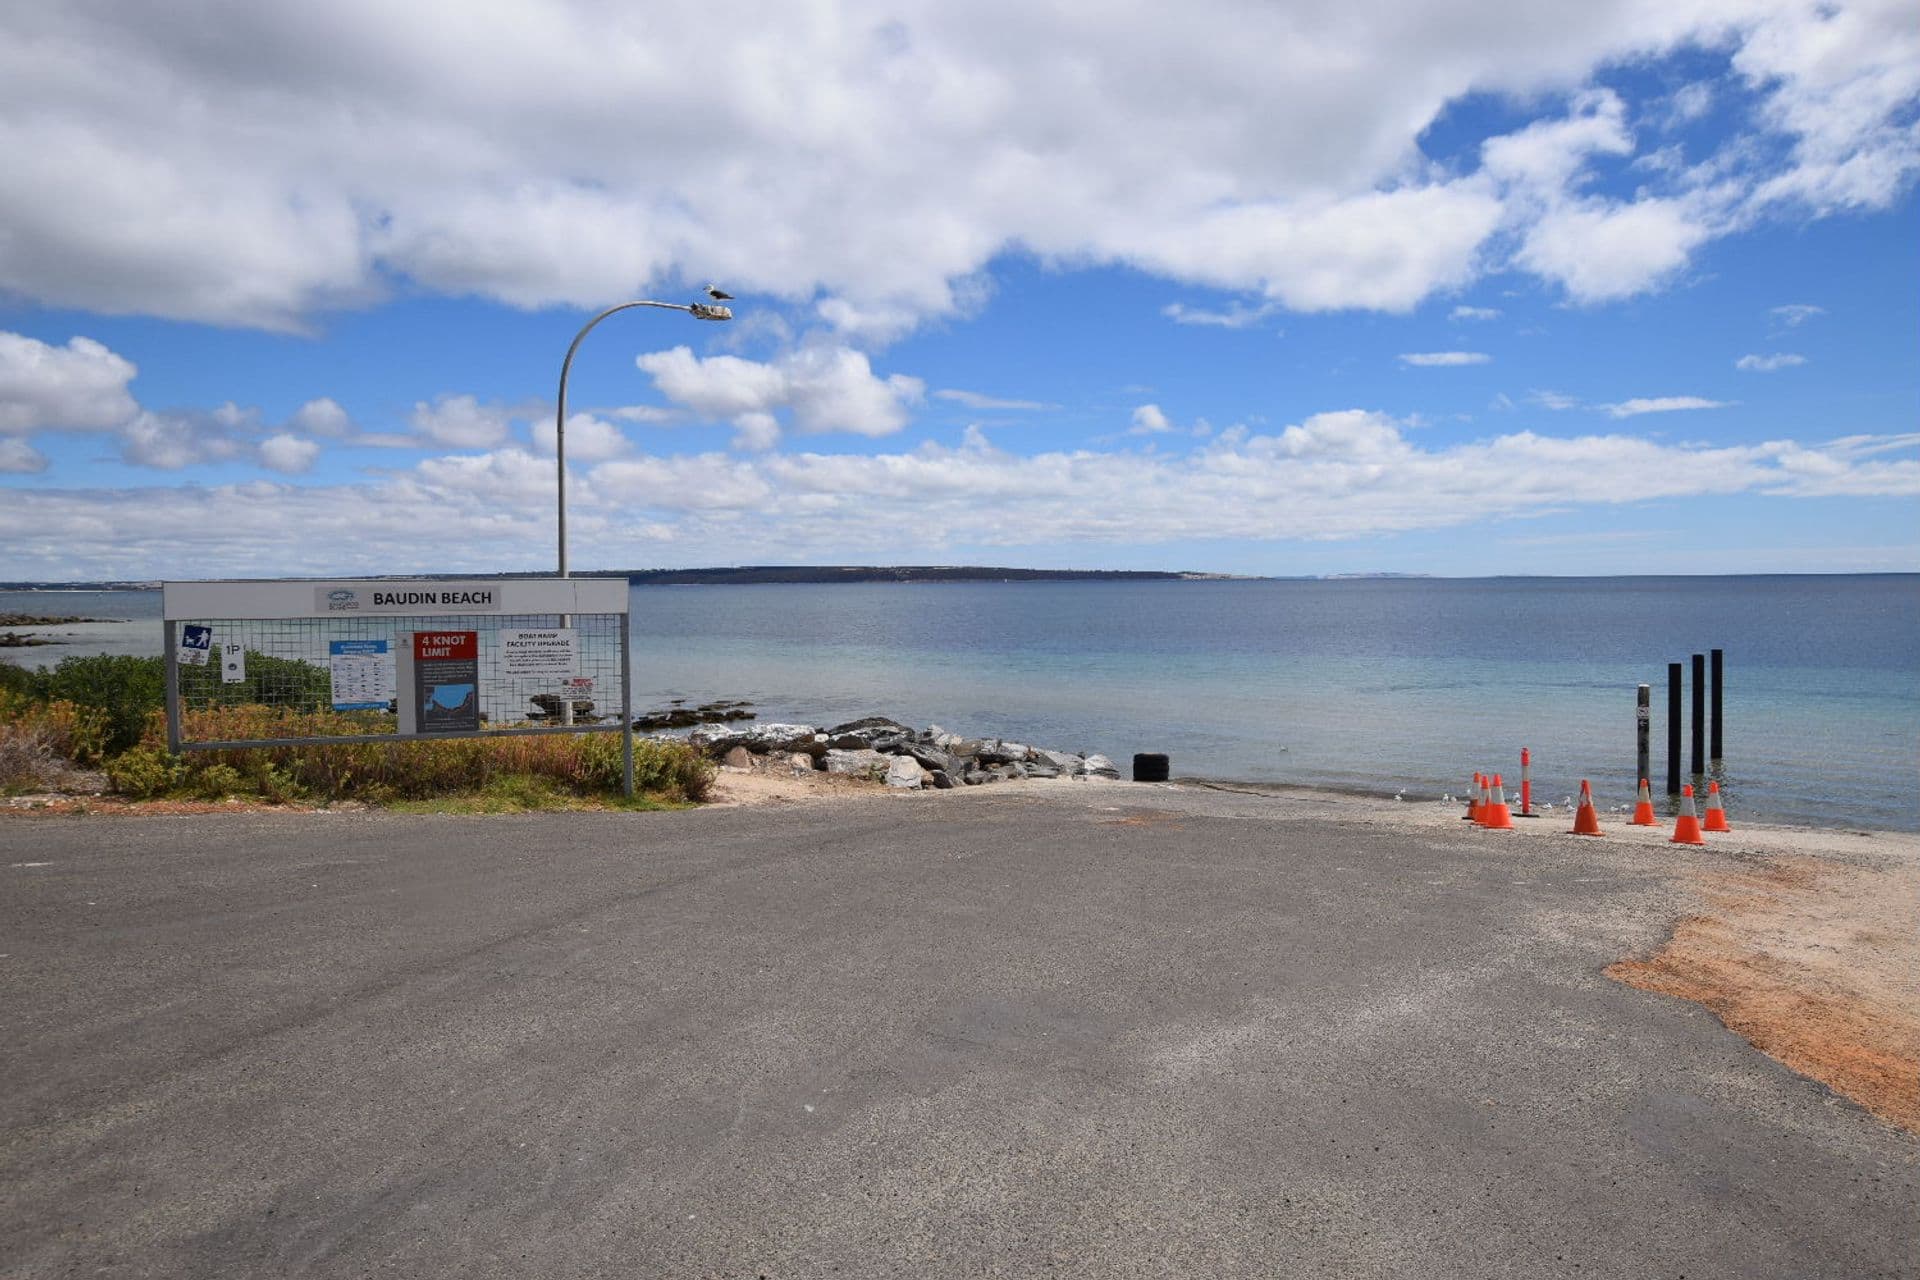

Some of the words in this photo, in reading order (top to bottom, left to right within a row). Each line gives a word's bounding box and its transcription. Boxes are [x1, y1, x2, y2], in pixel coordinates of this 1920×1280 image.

[373, 592, 436, 605] BAUDIN
[441, 592, 492, 604] BEACH
[422, 636, 430, 646] 4
[433, 635, 466, 646] KNOT
[226, 645, 240, 655] 1P
[422, 647, 451, 657] LIMIT
